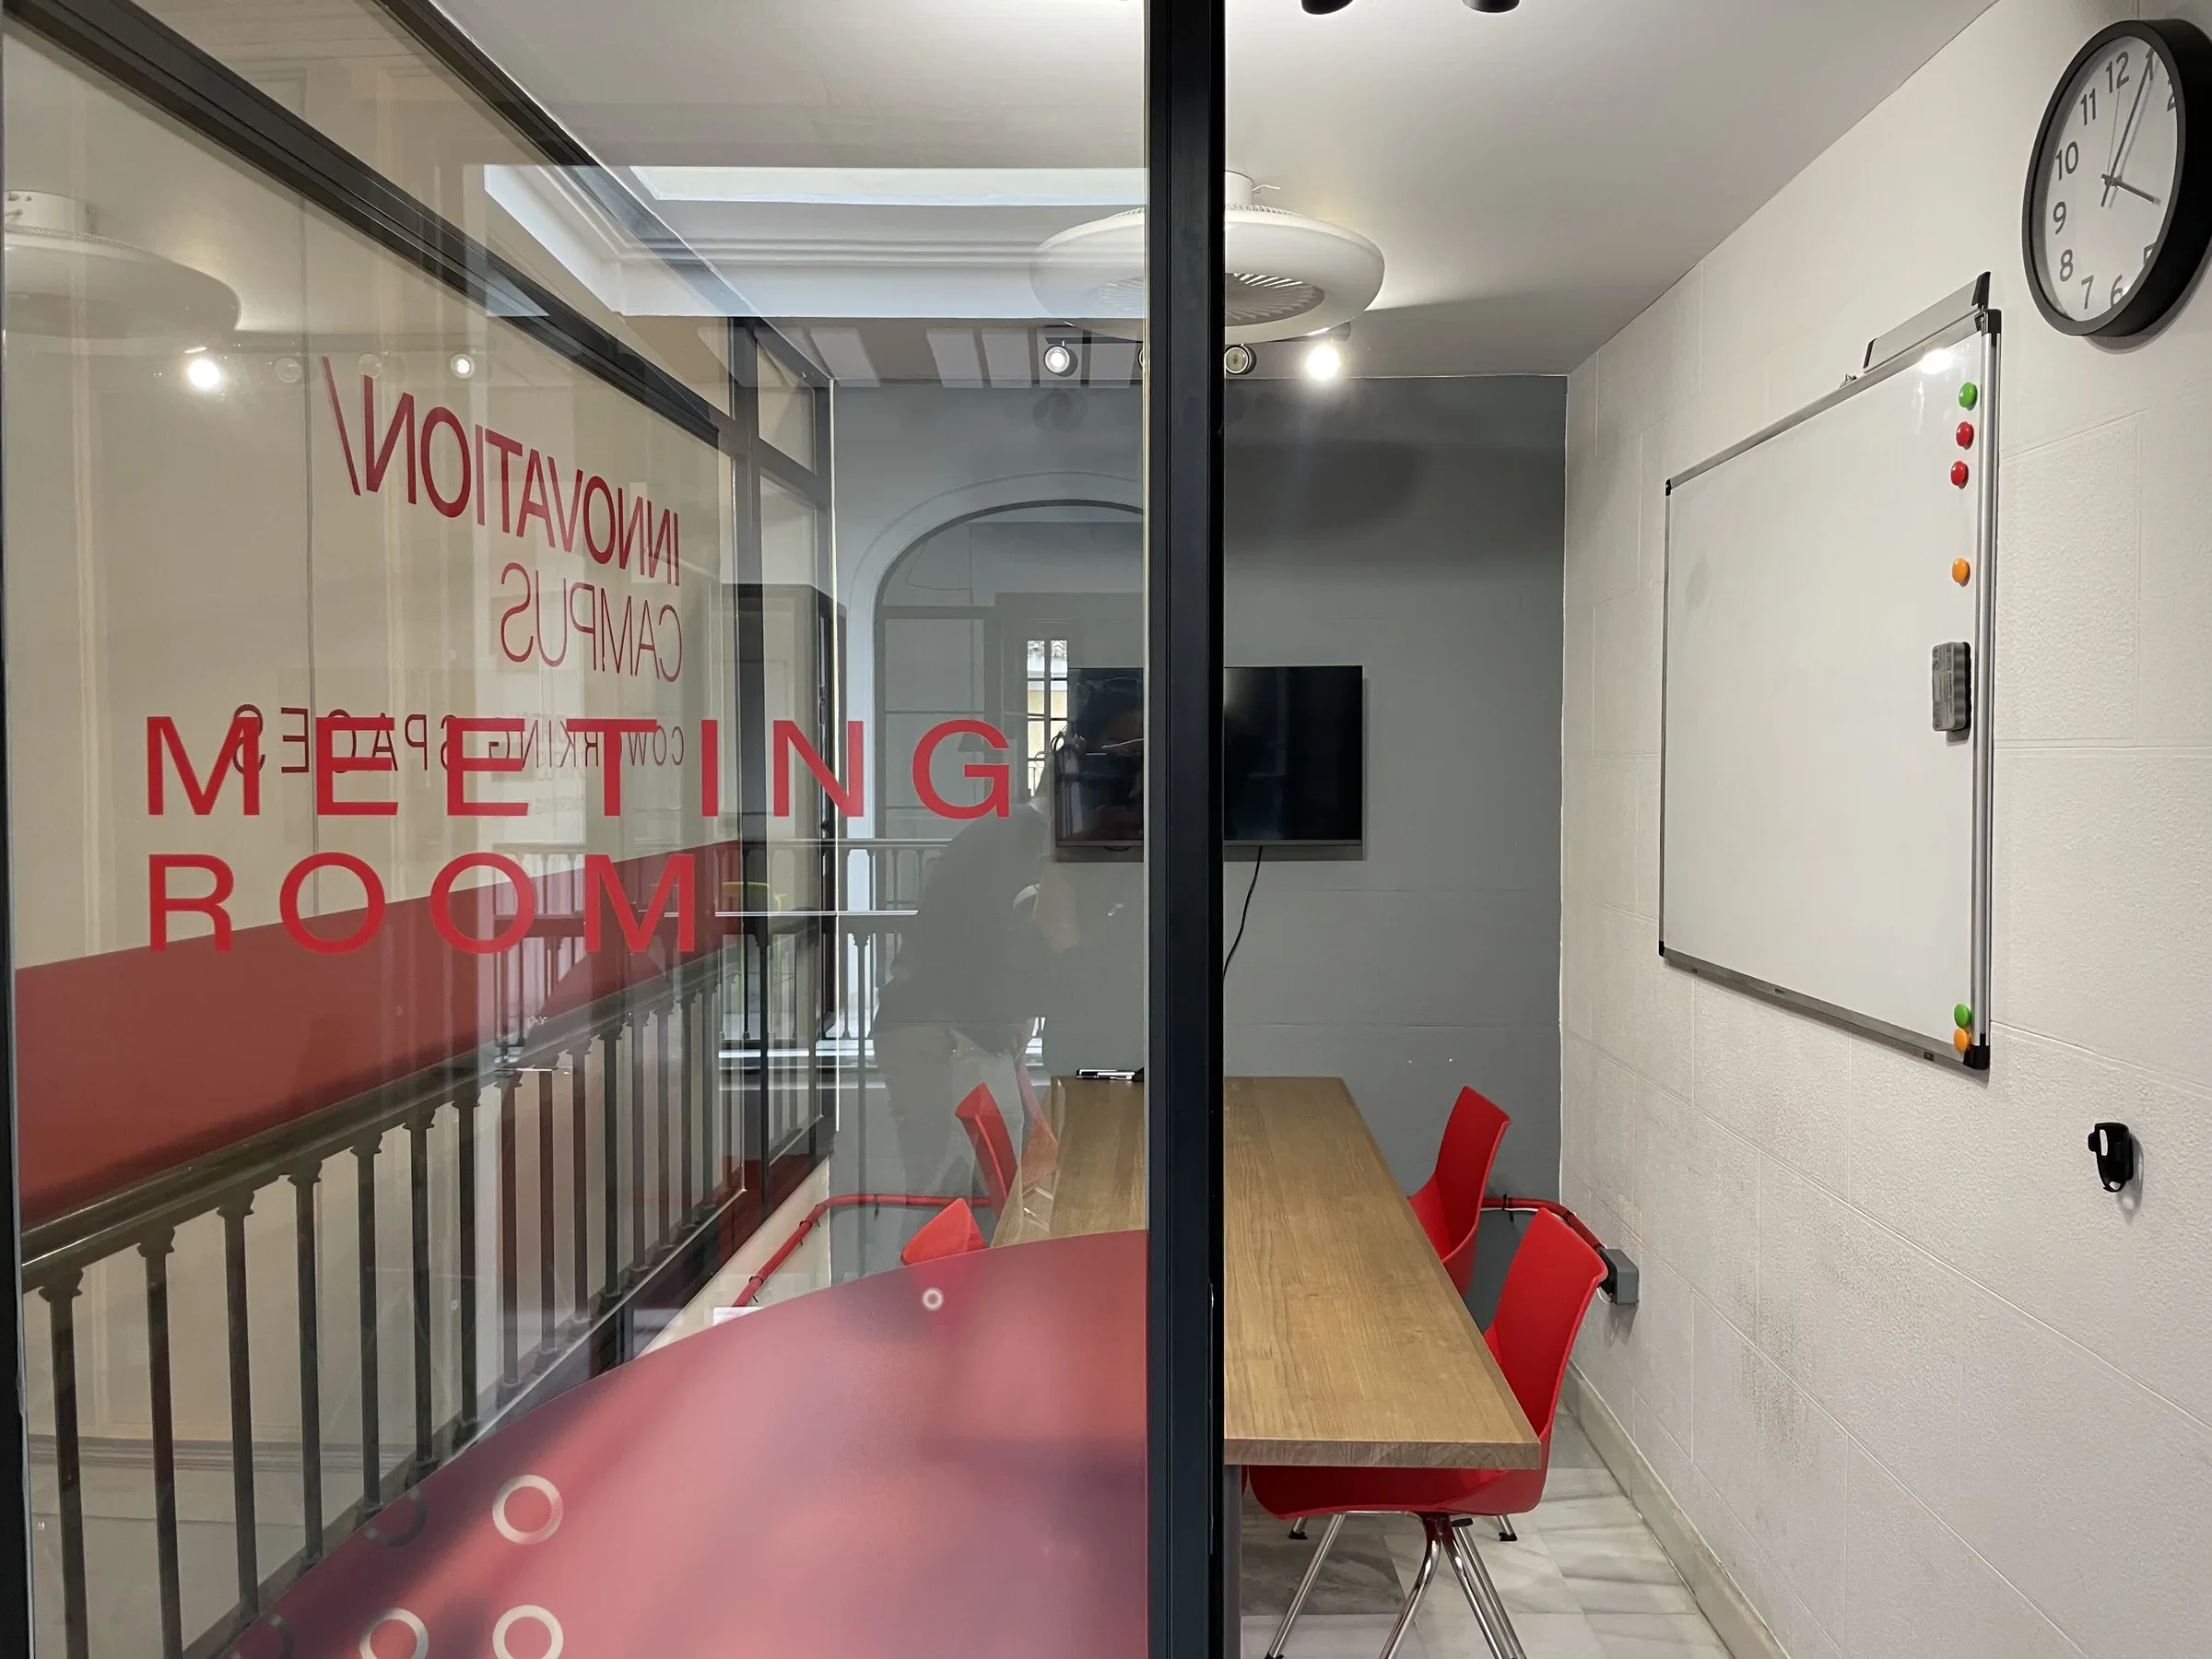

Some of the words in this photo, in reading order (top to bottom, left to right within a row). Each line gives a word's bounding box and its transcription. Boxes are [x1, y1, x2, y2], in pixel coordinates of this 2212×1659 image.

[2105, 51, 2130, 94] 12
[2080, 88, 2097, 126] 11
[2055, 140, 2079, 182] 10
[2053, 201, 2067, 235] 9
[2059, 249, 2074, 282] 8
[2080, 275, 2094, 310] 7
[2110, 274, 2124, 309] 6
[147, 715, 1010, 820] MEETING
[148, 852, 696, 955] ROOM
